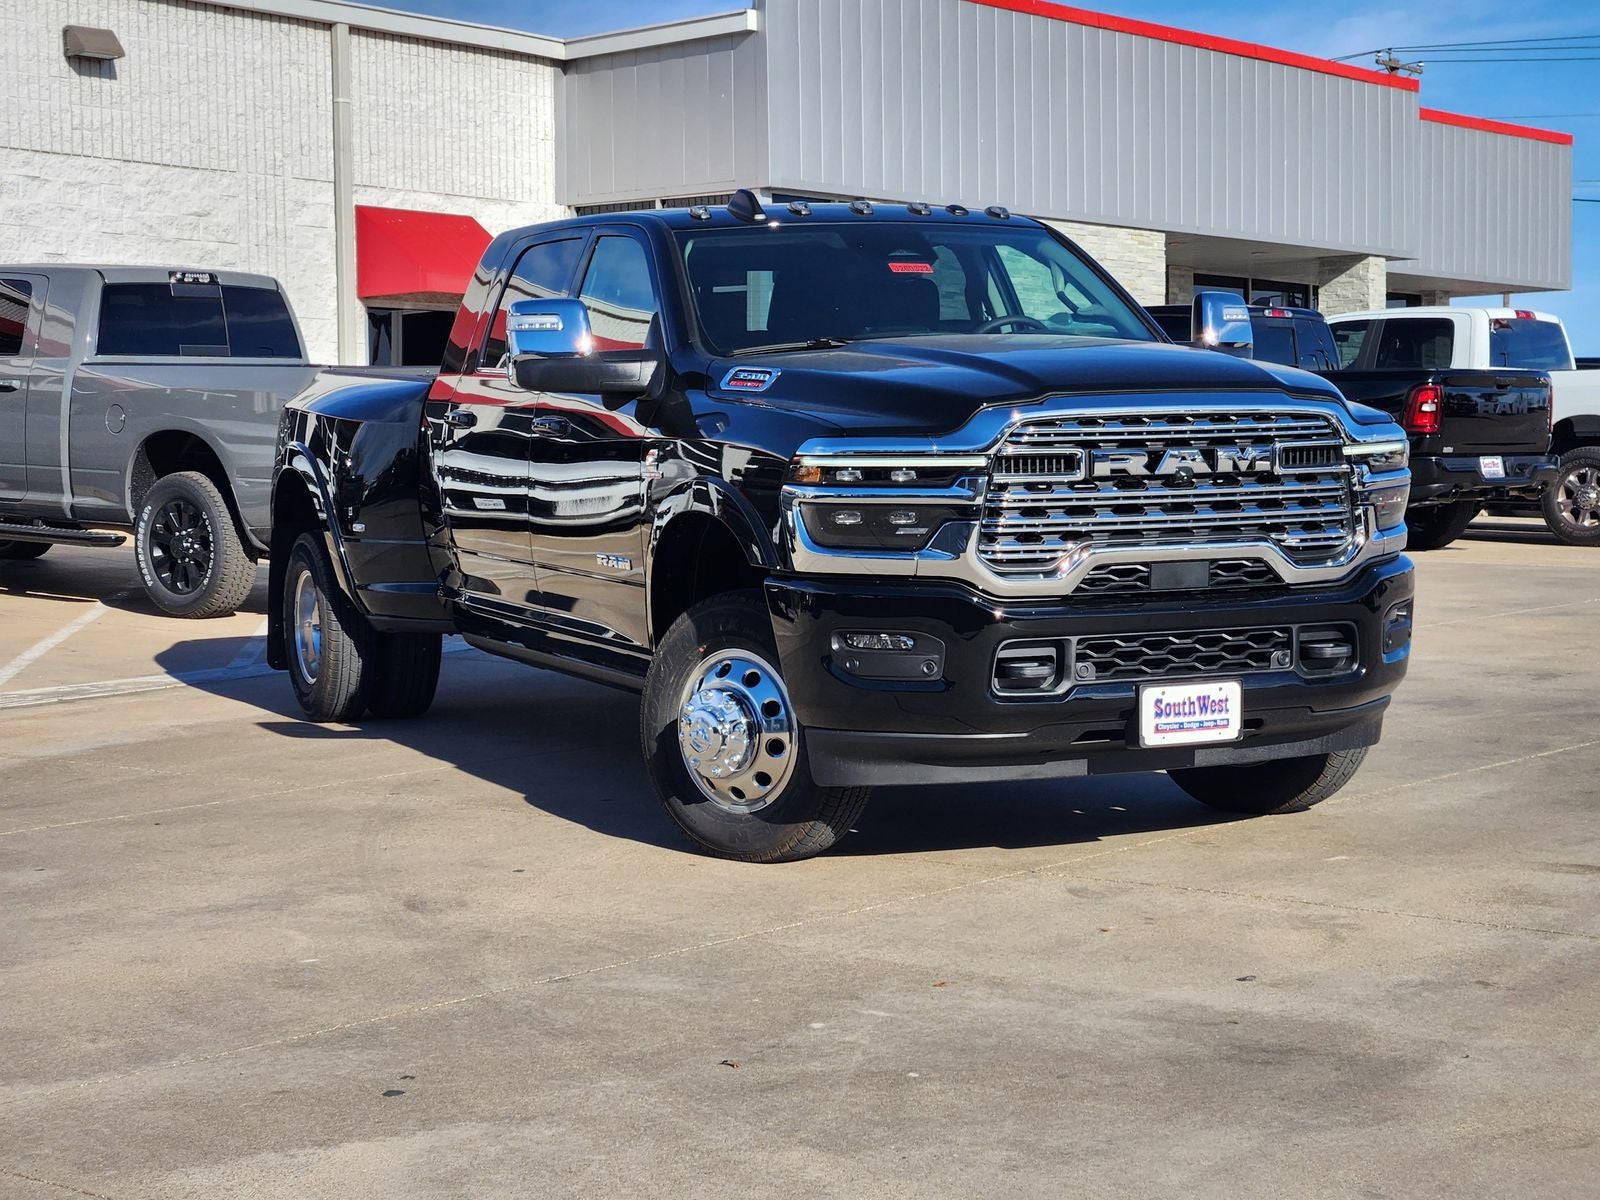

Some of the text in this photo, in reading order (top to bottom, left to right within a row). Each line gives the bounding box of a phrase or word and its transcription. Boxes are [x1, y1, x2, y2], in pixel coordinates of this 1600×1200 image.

[734, 371, 769, 380] 3500
[1092, 448, 1272, 476] RAM
[596, 553, 632, 571] RAM
[1154, 695, 1229, 719] SouthWest
[1183, 721, 1200, 729] Dodge
